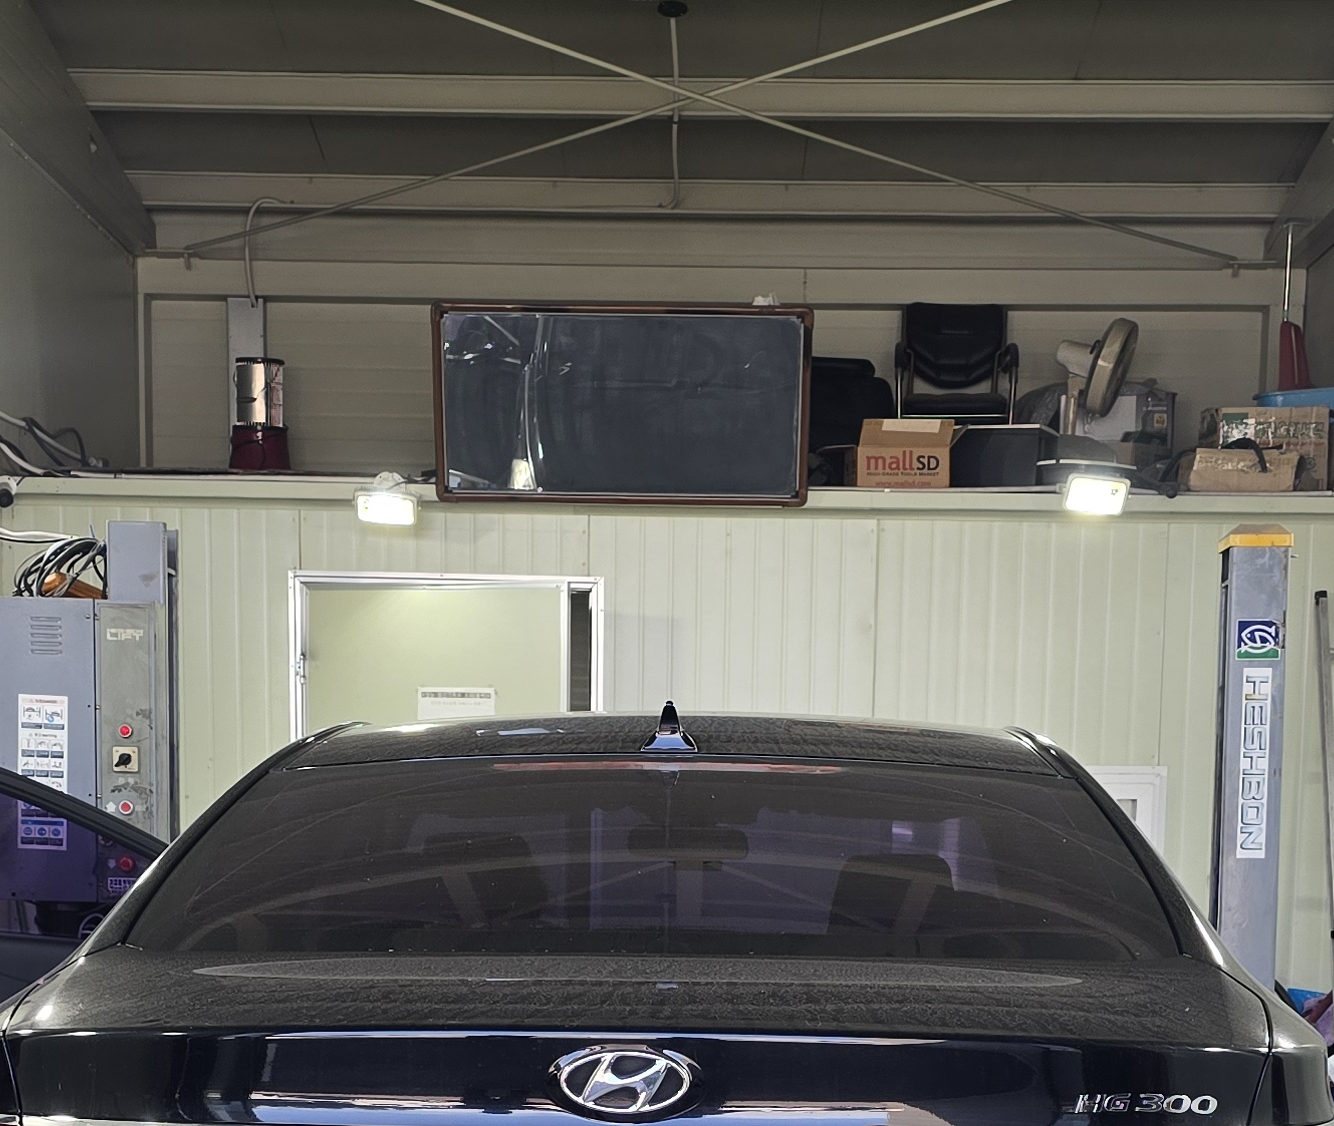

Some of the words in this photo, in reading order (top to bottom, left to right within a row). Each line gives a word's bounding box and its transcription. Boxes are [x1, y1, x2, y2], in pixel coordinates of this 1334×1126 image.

[866, 450, 940, 471] mallSD
[1240, 675, 1270, 850] HESHBON
[1075, 1093, 1132, 1114] HG
[1134, 1093, 1218, 1115] 300
